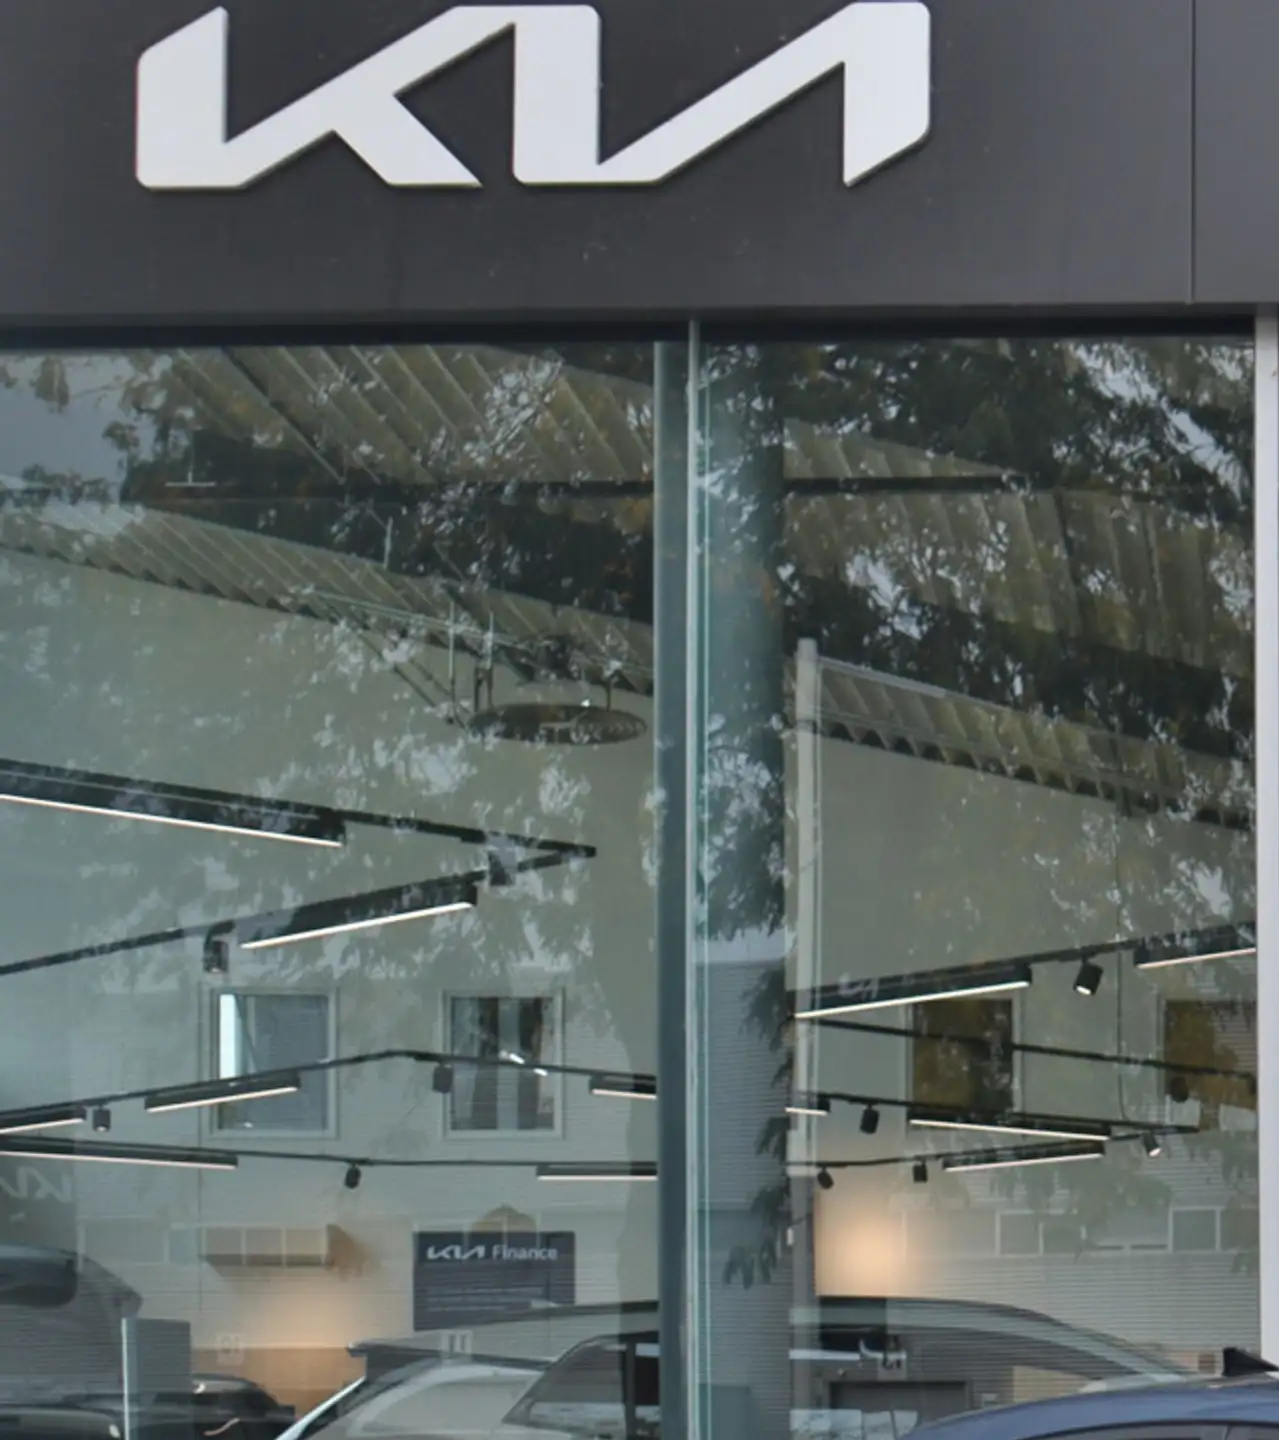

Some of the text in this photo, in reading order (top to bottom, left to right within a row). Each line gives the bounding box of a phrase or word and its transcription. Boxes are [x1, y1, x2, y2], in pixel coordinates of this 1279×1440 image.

[134, 1, 932, 189] KIA
[427, 1243, 558, 1262] KIA Finance
